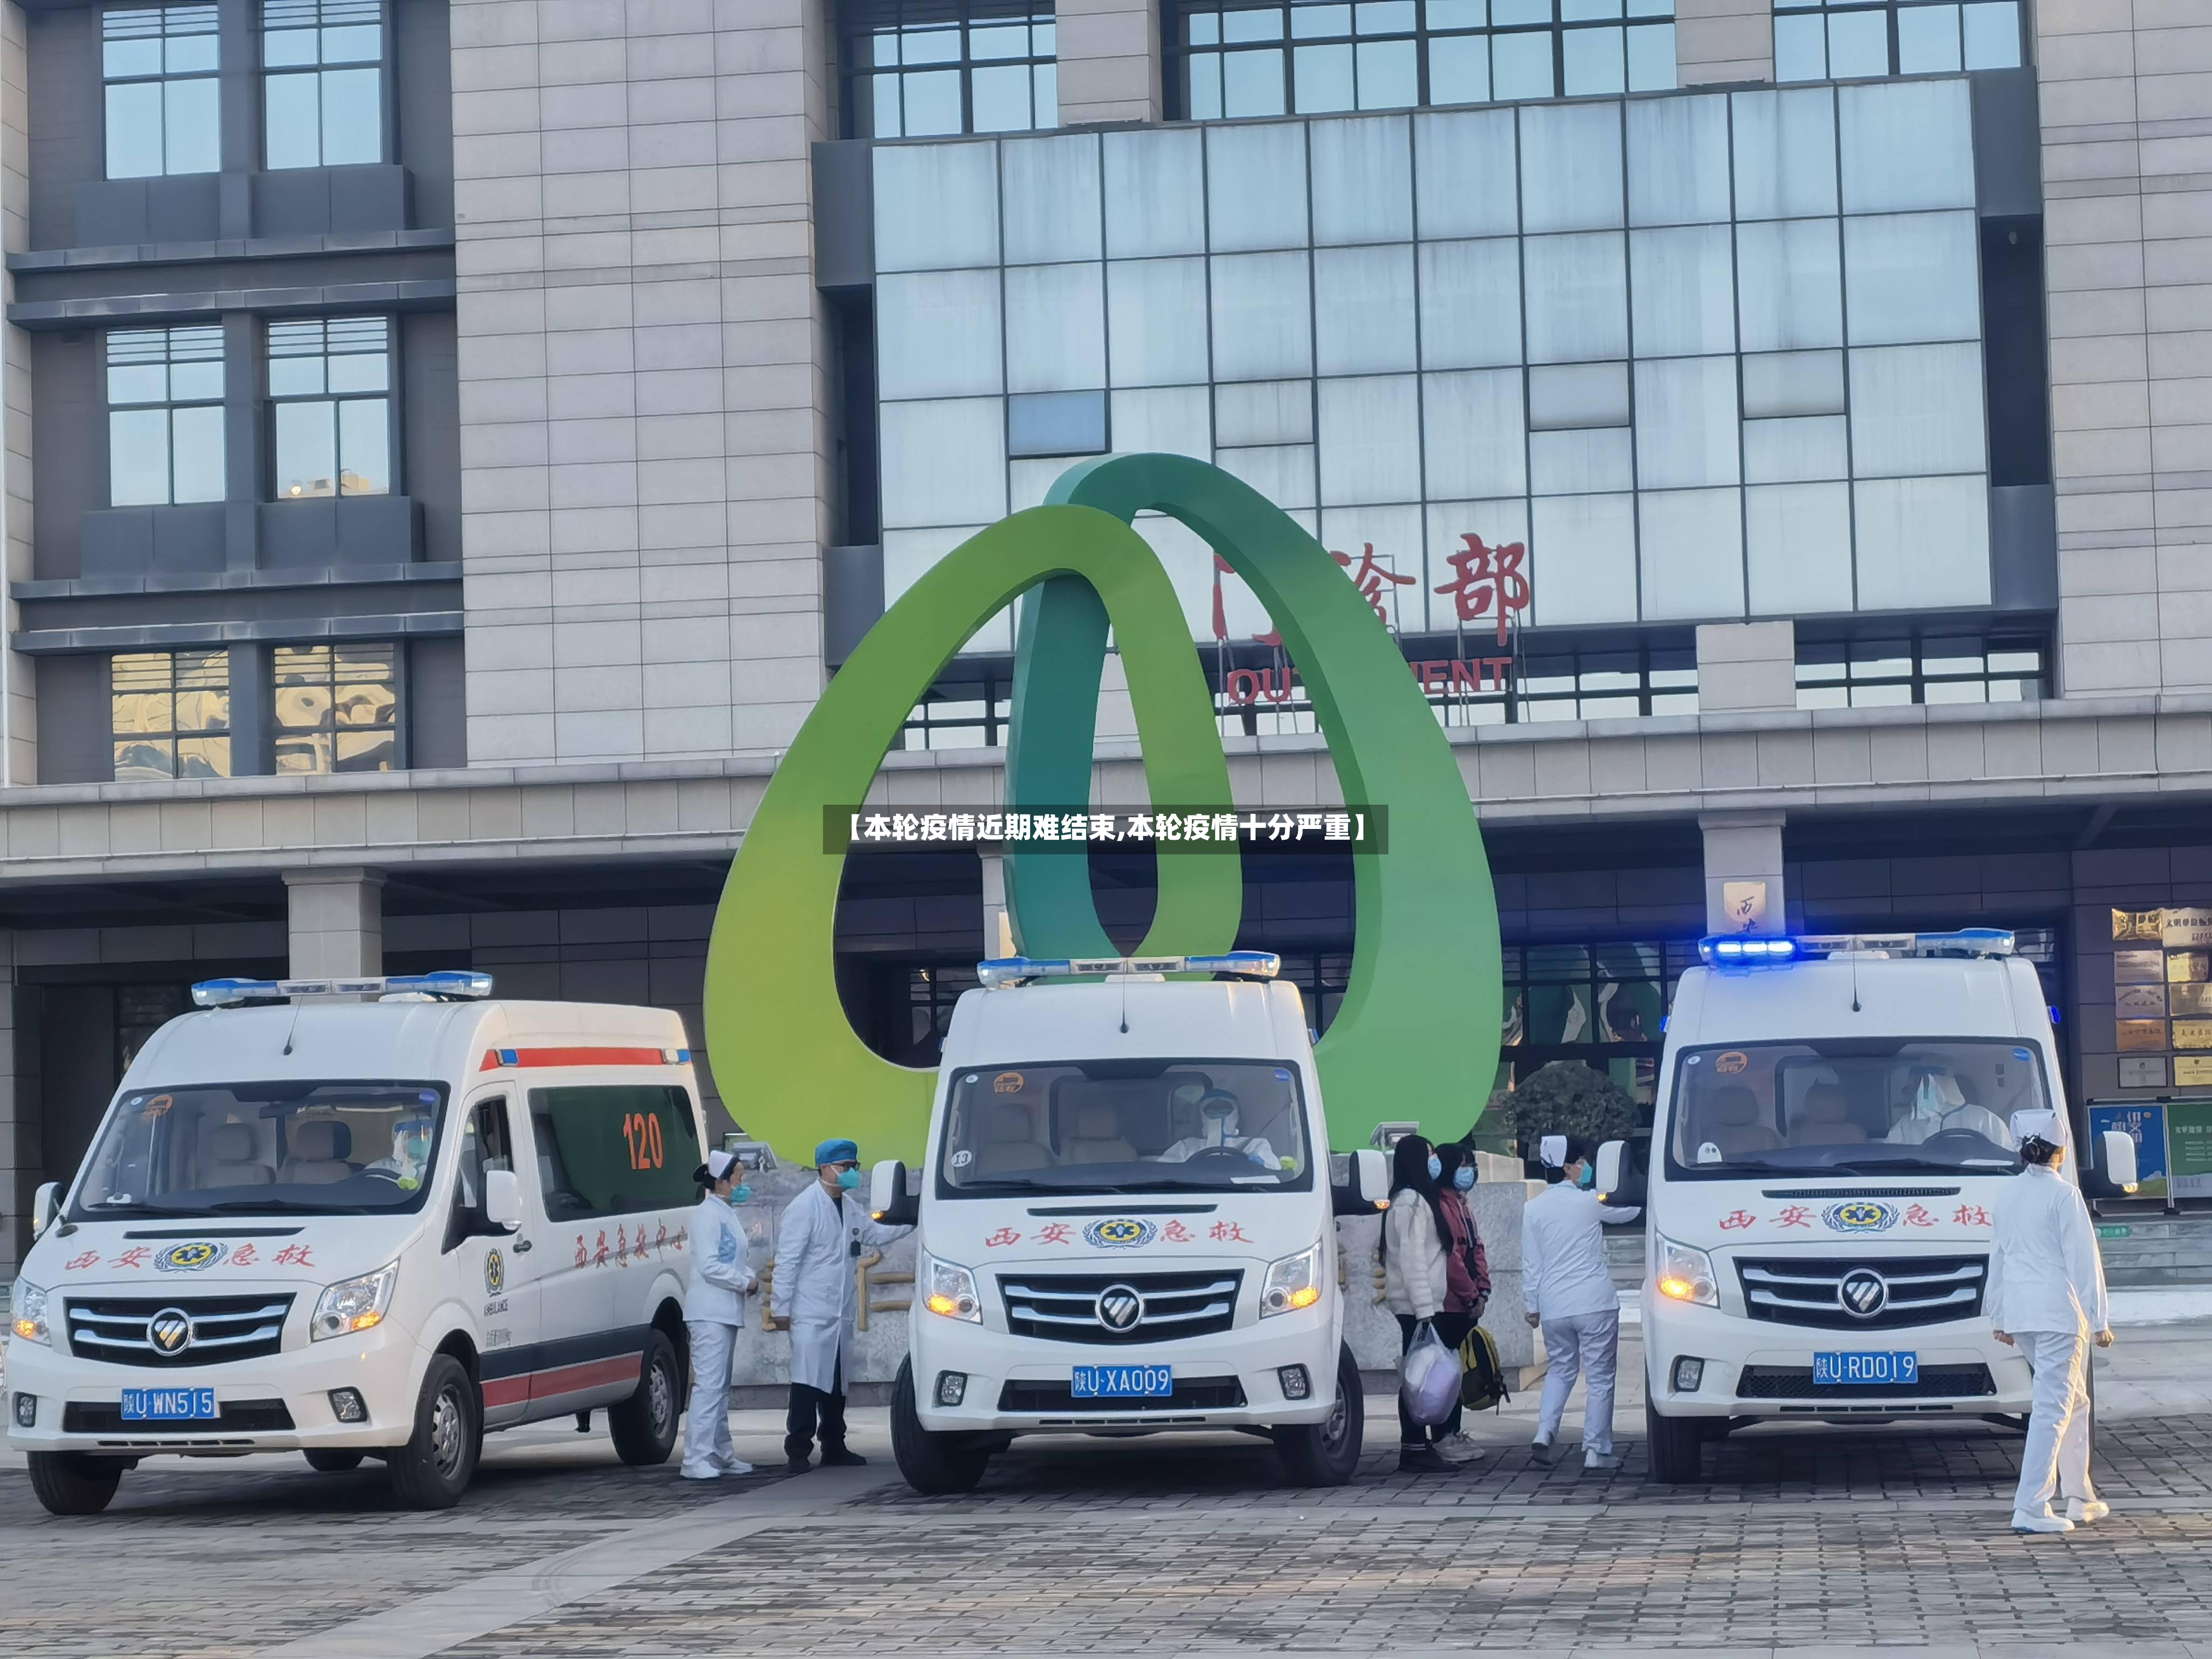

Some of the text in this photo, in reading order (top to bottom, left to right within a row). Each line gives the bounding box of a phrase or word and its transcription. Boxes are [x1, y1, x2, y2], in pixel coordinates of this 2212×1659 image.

[1227, 657, 1512, 704] OU ENT
[623, 1113, 663, 1169] 120
[954, 1153, 968, 1165] 13
